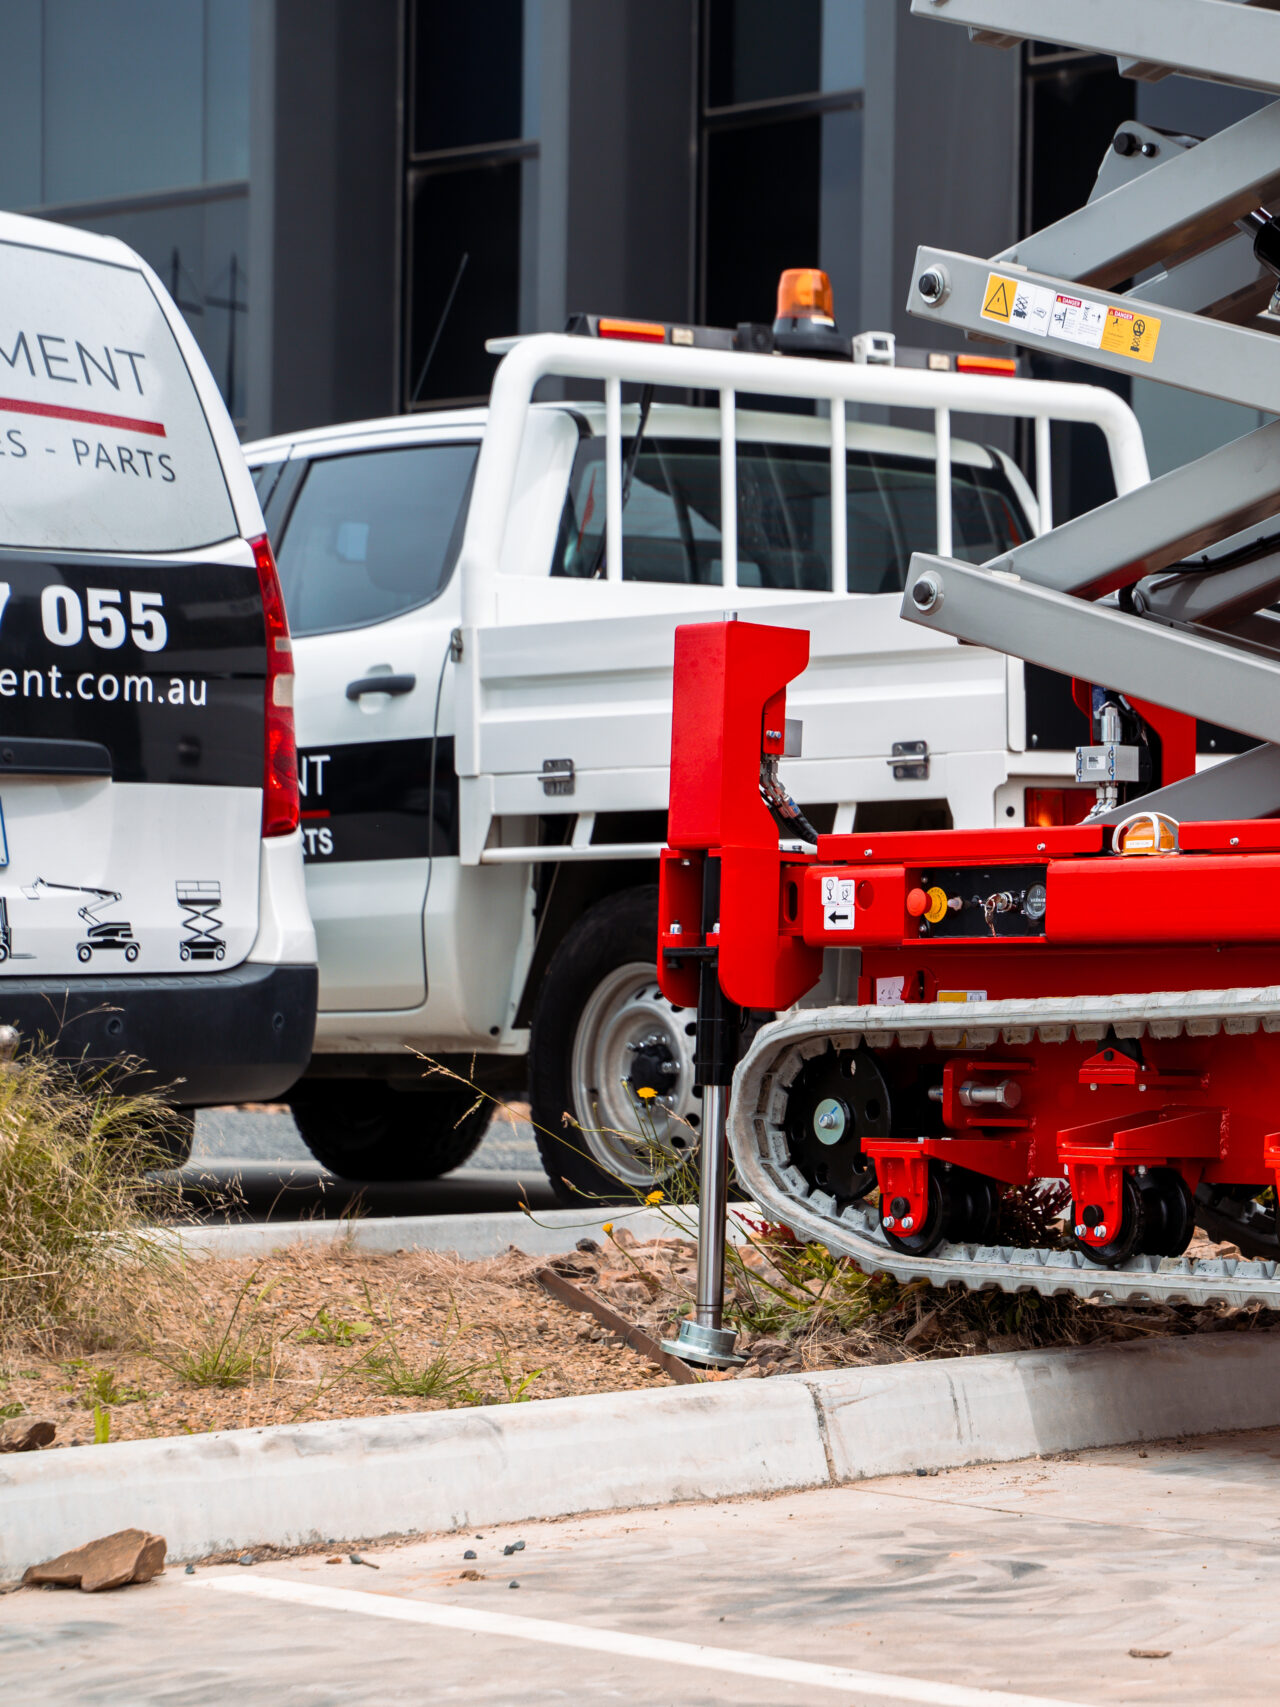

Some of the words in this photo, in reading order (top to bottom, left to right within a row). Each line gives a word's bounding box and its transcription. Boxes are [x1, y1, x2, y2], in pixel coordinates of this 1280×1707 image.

[1062, 297, 1081, 308] DANGER
[1115, 310, 1134, 321] DANGER
[72, 438, 176, 482] PARTS
[40, 584, 168, 652] 055
[0, 664, 207, 706] ent.com.au
